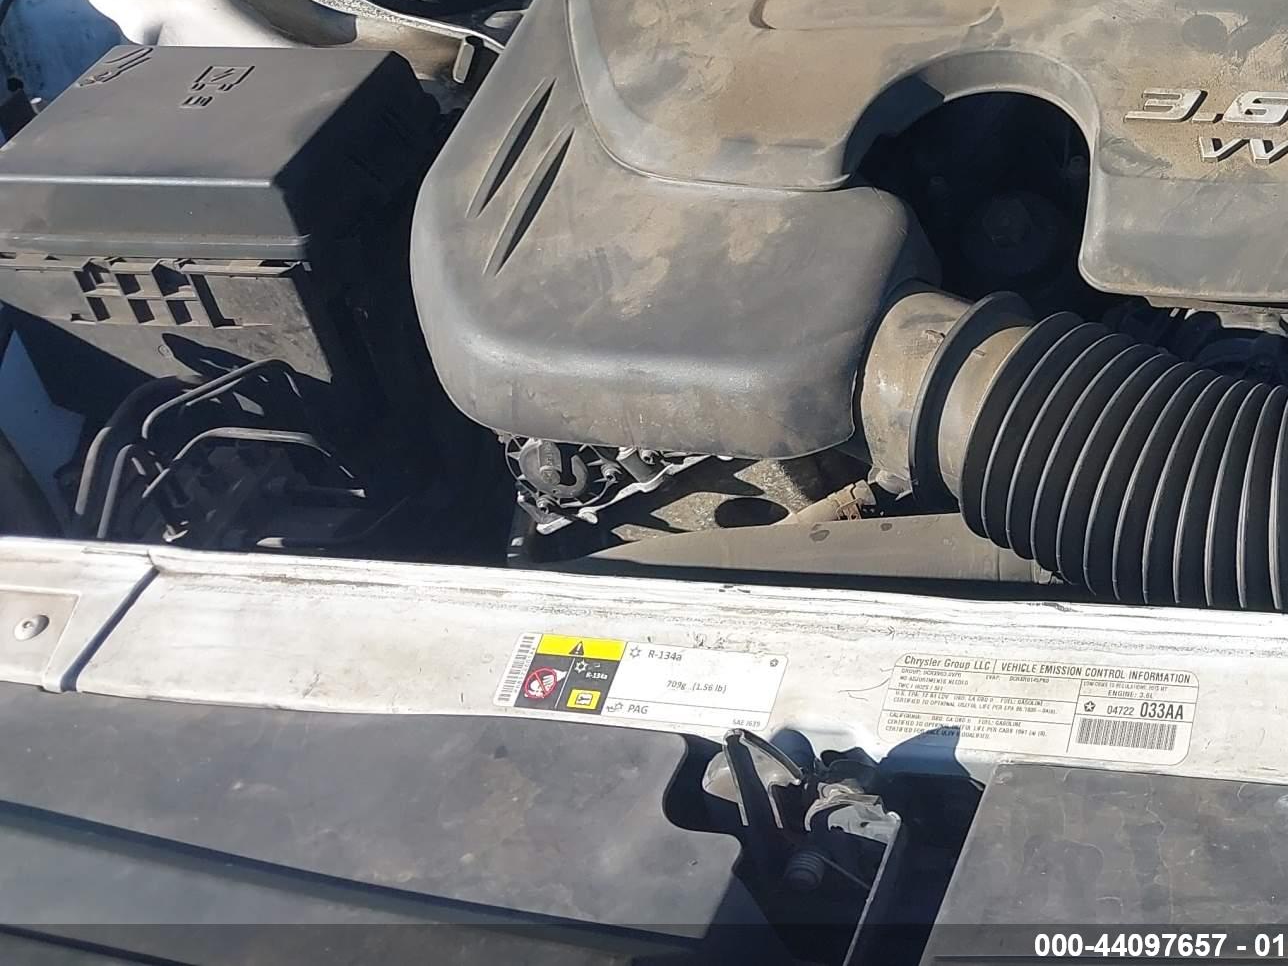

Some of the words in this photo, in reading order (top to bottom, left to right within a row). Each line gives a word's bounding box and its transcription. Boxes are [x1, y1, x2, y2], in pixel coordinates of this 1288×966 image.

[648, 649, 683, 661] R-134a
[904, 655, 941, 667] Chrysler
[944, 658, 971, 670] Group
[974, 660, 991, 670] LLC
[1001, 662, 1037, 673] VEHICLE
[1039, 664, 1082, 676] EMISSION
[1085, 667, 1125, 679] CONTROL
[1129, 670, 1191, 683] INFORMATION
[1107, 689, 1137, 698] ENGINE:
[627, 704, 648, 715] PAG
[1107, 705, 1135, 716] 04722
[1140, 702, 1183, 720] 033AA
